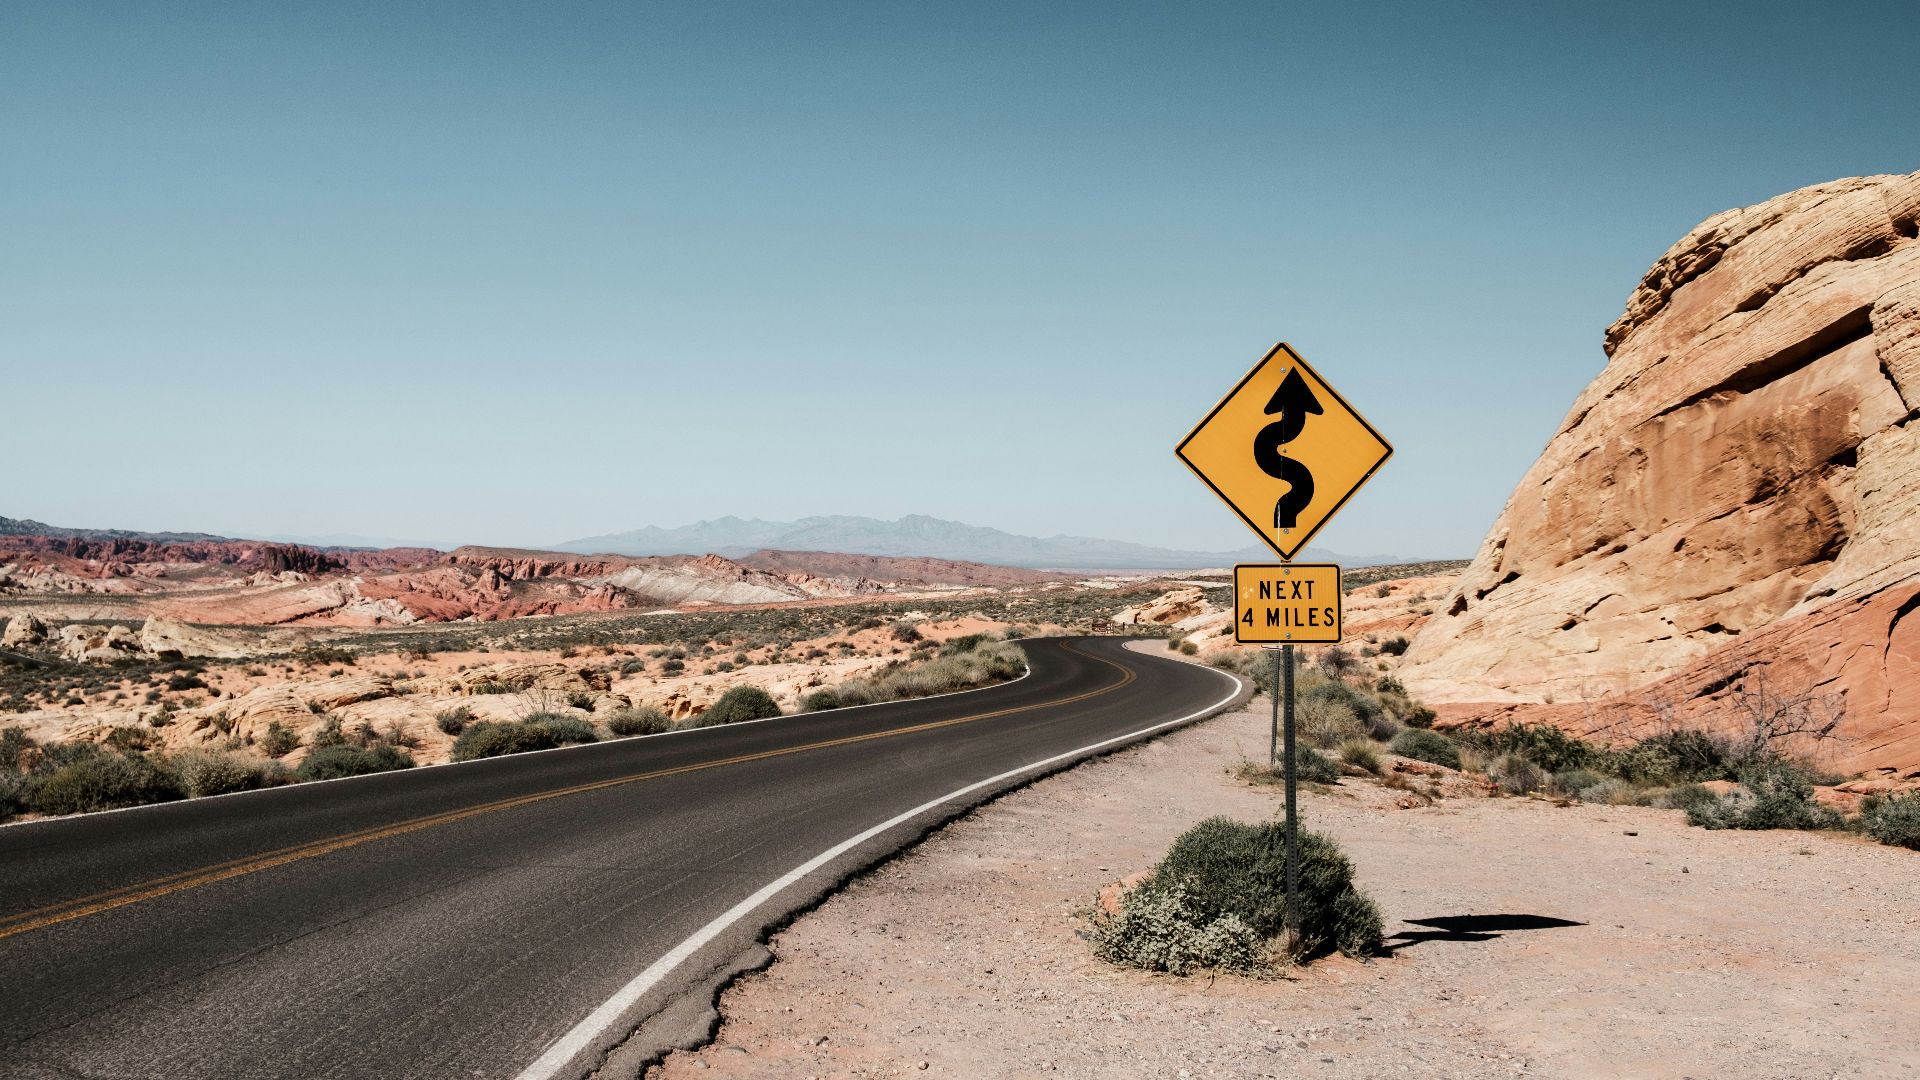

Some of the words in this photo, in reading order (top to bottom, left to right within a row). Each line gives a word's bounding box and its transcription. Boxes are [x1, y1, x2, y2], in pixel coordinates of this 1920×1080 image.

[1259, 580, 1315, 600] NEXT
[1241, 607, 1254, 627] 4
[1266, 607, 1335, 627] MILES
